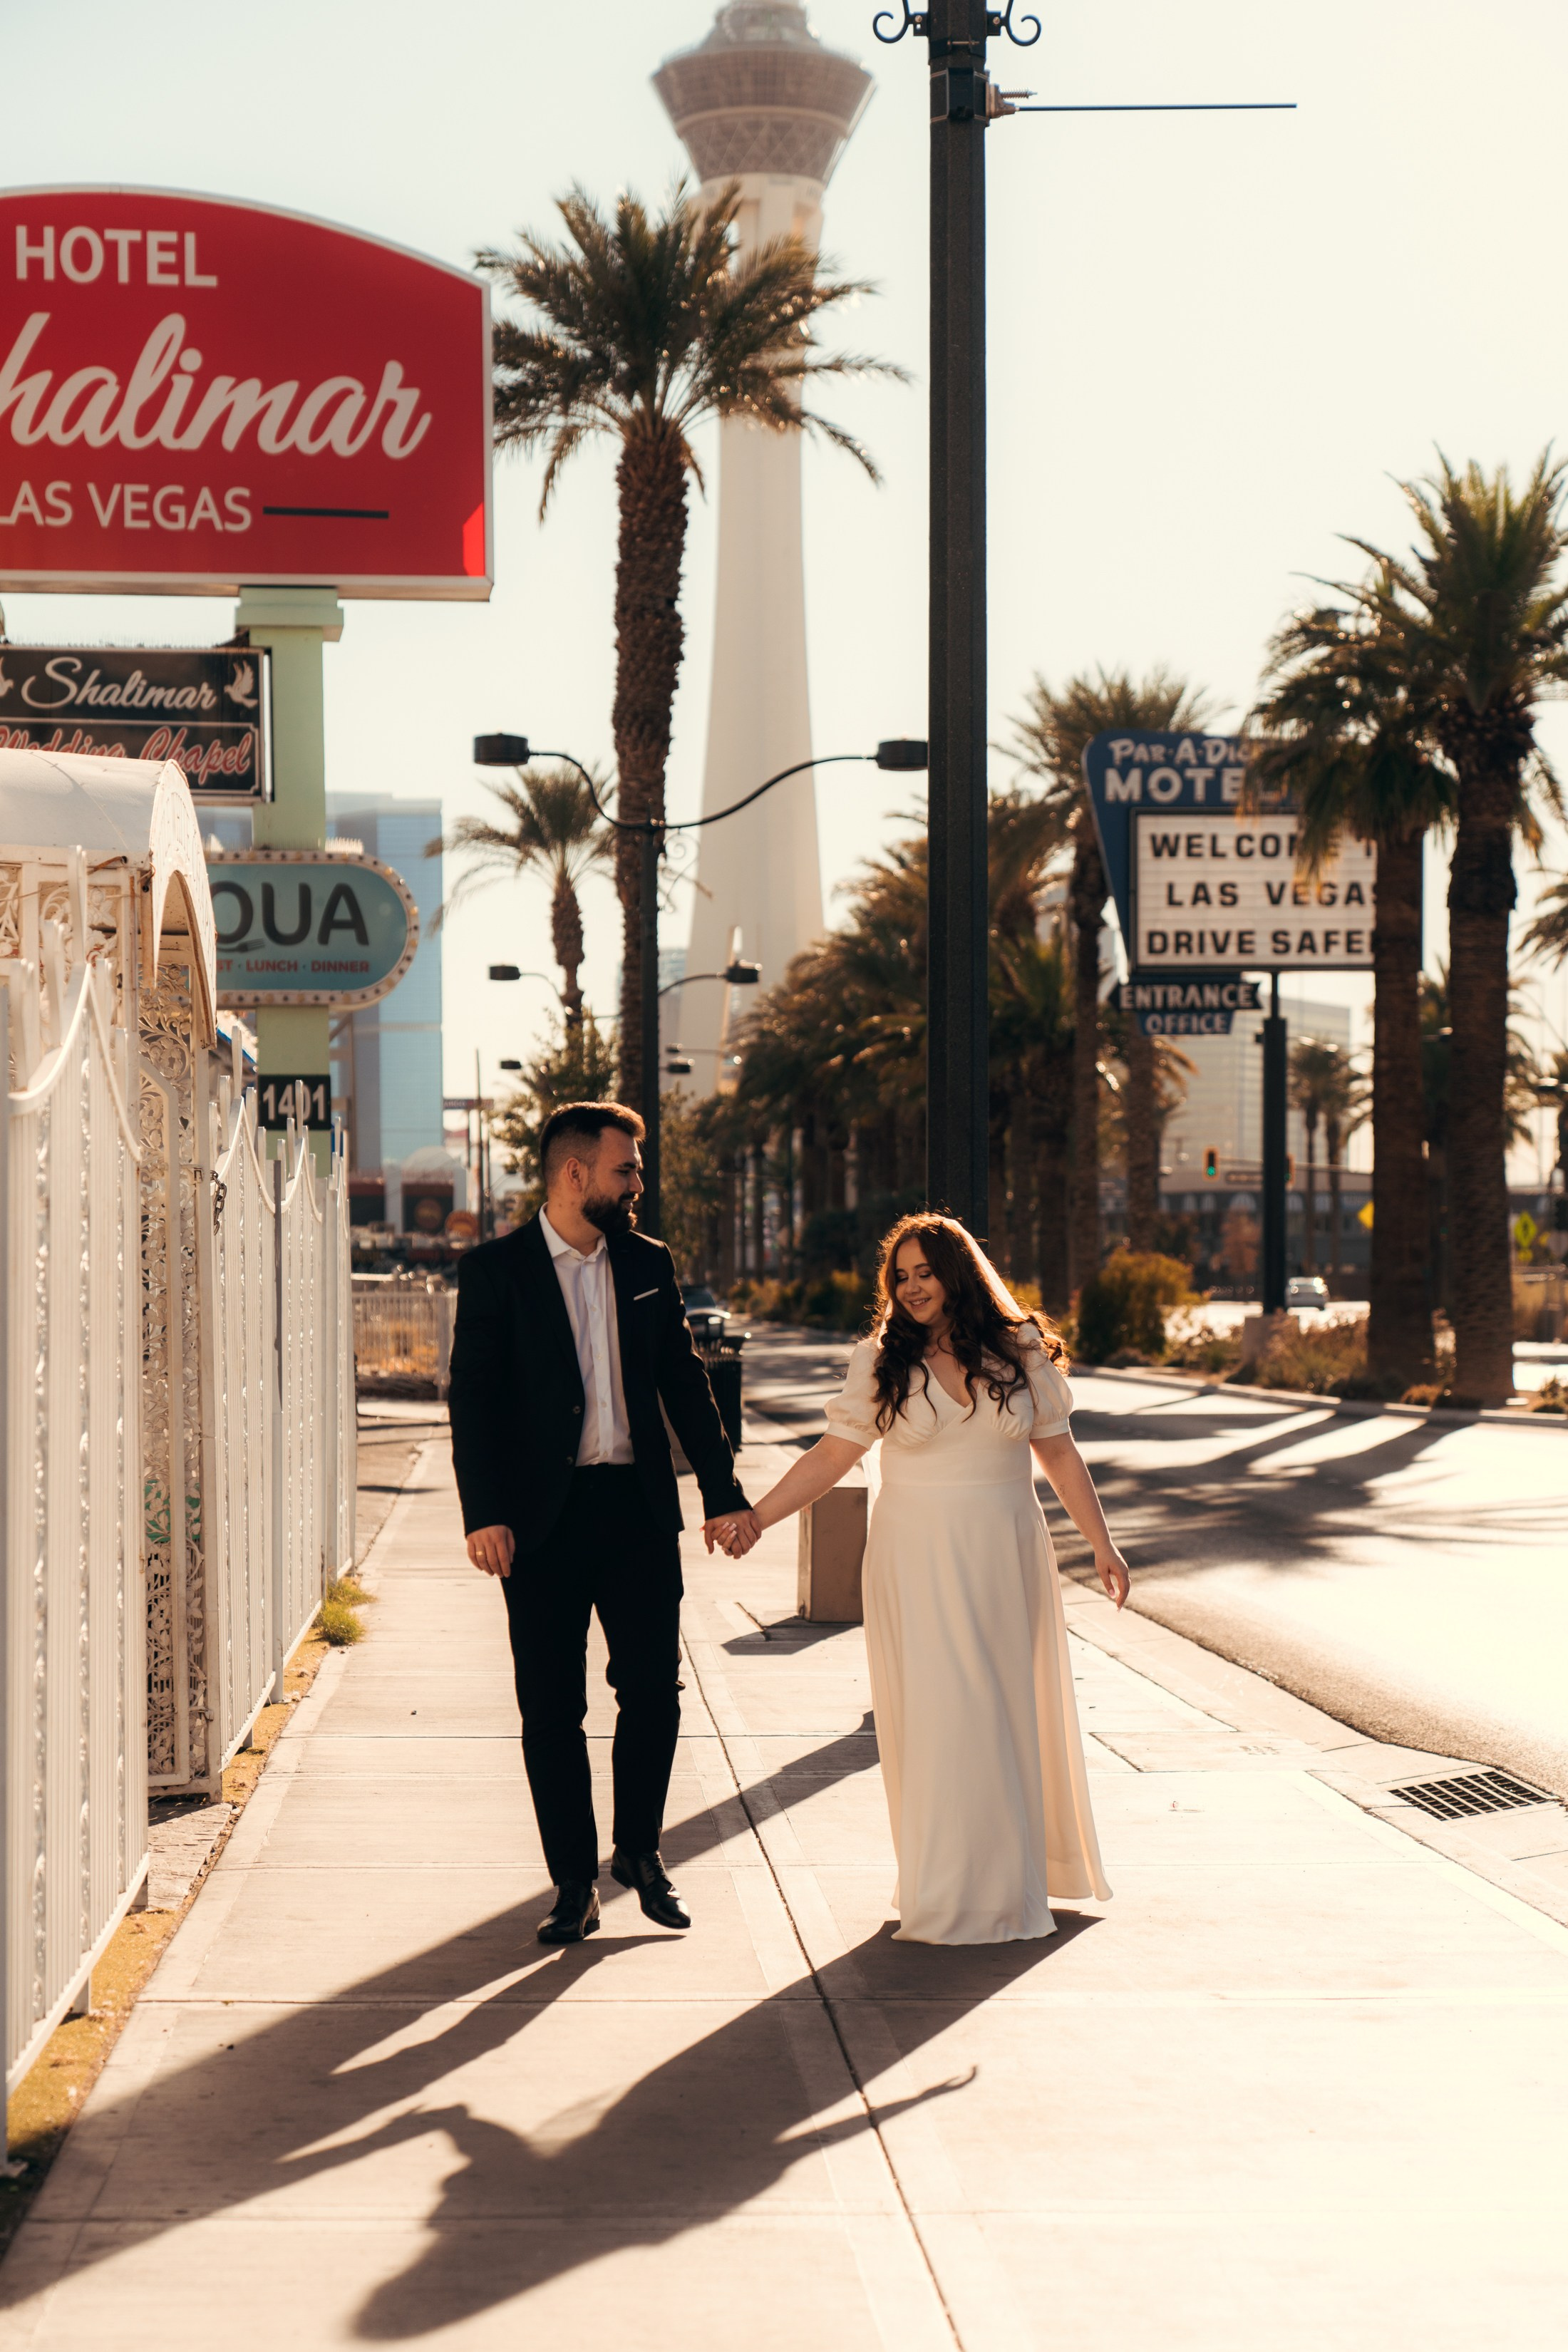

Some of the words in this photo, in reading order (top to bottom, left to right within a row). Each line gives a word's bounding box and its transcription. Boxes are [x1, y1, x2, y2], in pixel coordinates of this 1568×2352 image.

[15, 225, 217, 288] HOTEL
[0, 480, 73, 527] AS
[86, 482, 252, 532] VEGAS
[21, 656, 217, 710] Shalimar
[140, 726, 252, 786] Chapel
[1150, 833, 1341, 858] WELCO
[1167, 882, 1239, 907] LAS
[1265, 881, 1377, 907] VEGA
[1147, 930, 1256, 955] DRIVE
[246, 959, 297, 973] LUNCH
[311, 959, 370, 974] DINNER
[1119, 983, 1254, 1009] ENTRANCE
[1145, 1013, 1227, 1033] OFFICE
